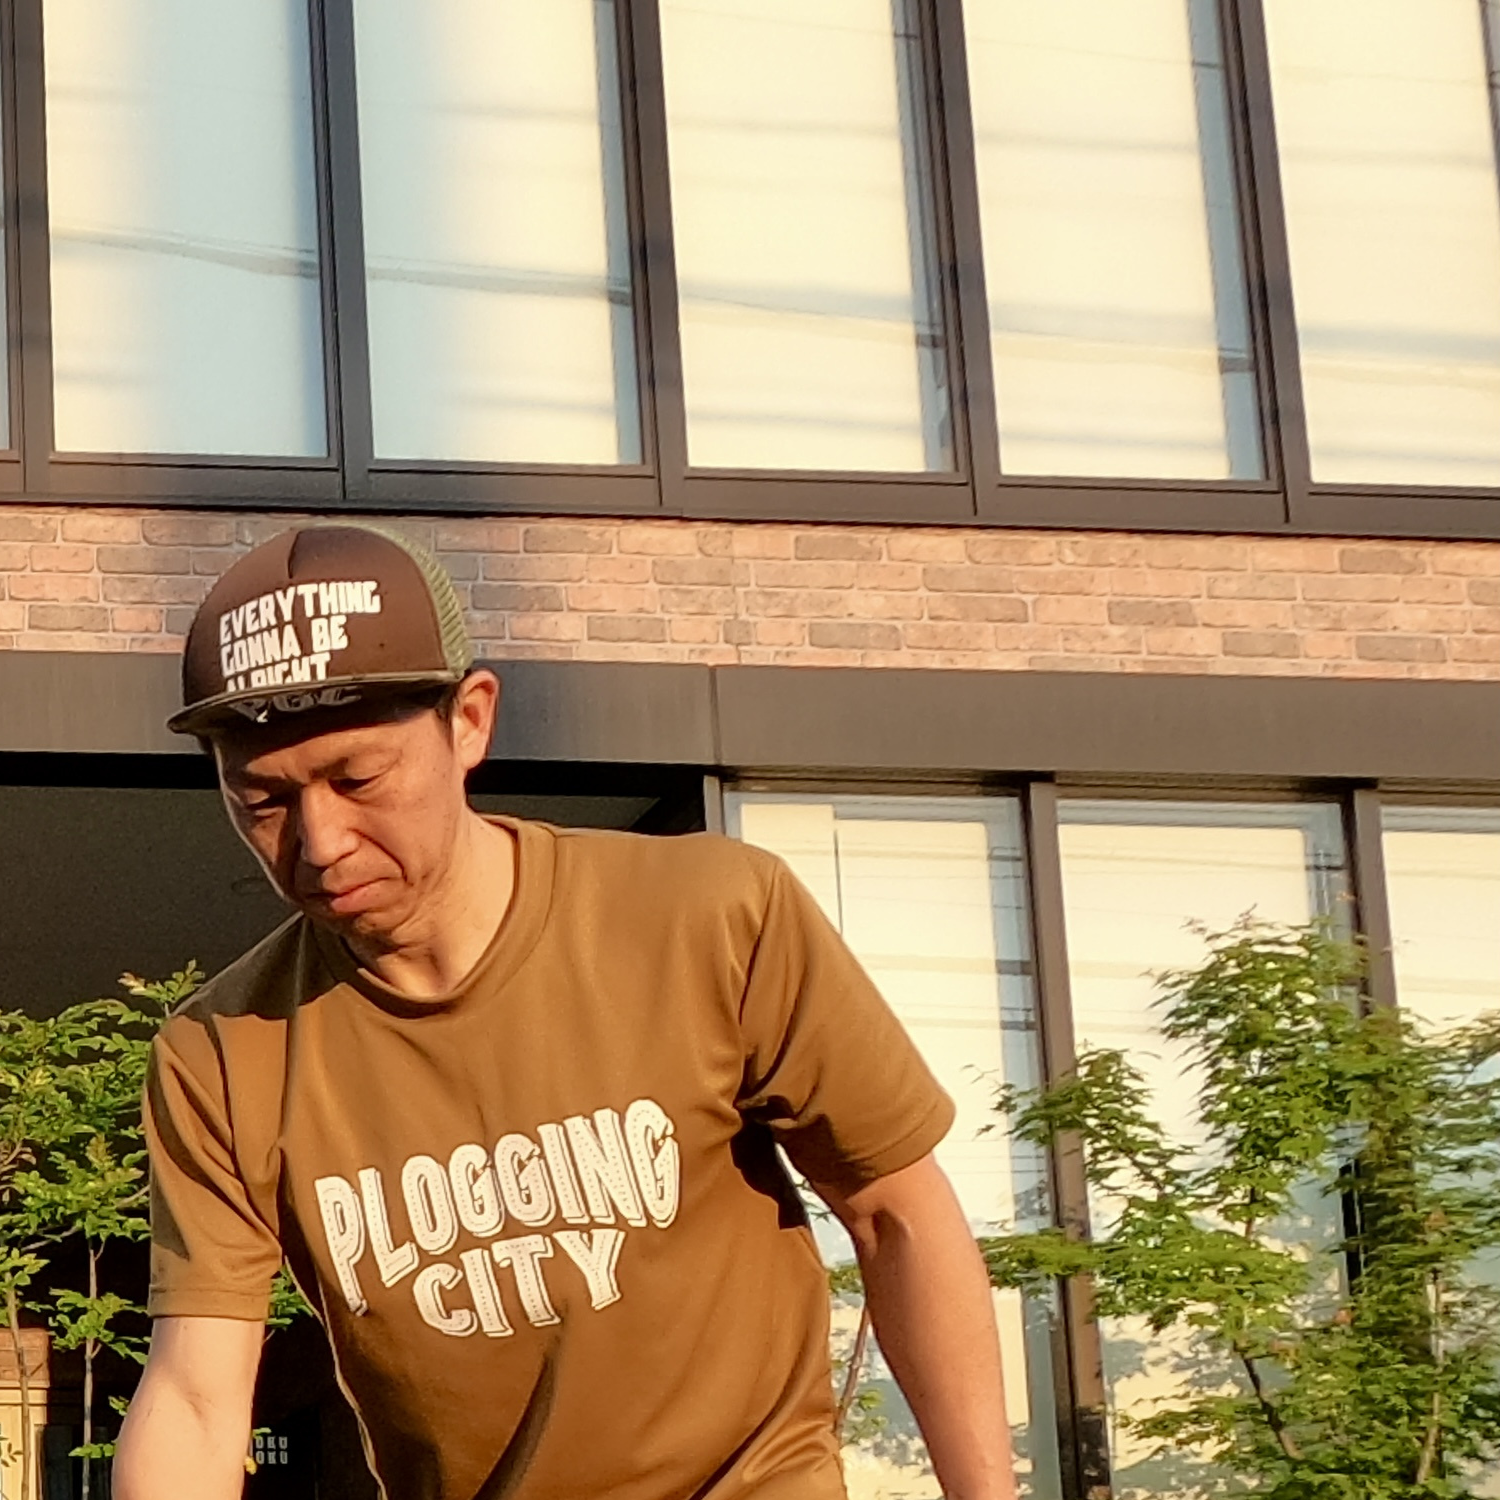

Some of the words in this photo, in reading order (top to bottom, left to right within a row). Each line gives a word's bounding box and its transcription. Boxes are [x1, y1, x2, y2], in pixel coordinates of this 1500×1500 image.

[219, 581, 381, 645] EVERYTHING
[221, 624, 301, 678] GONNA
[311, 615, 348, 653] BE
[314, 1098, 680, 1316] PLOGGING
[413, 1228, 626, 1337] CITY
